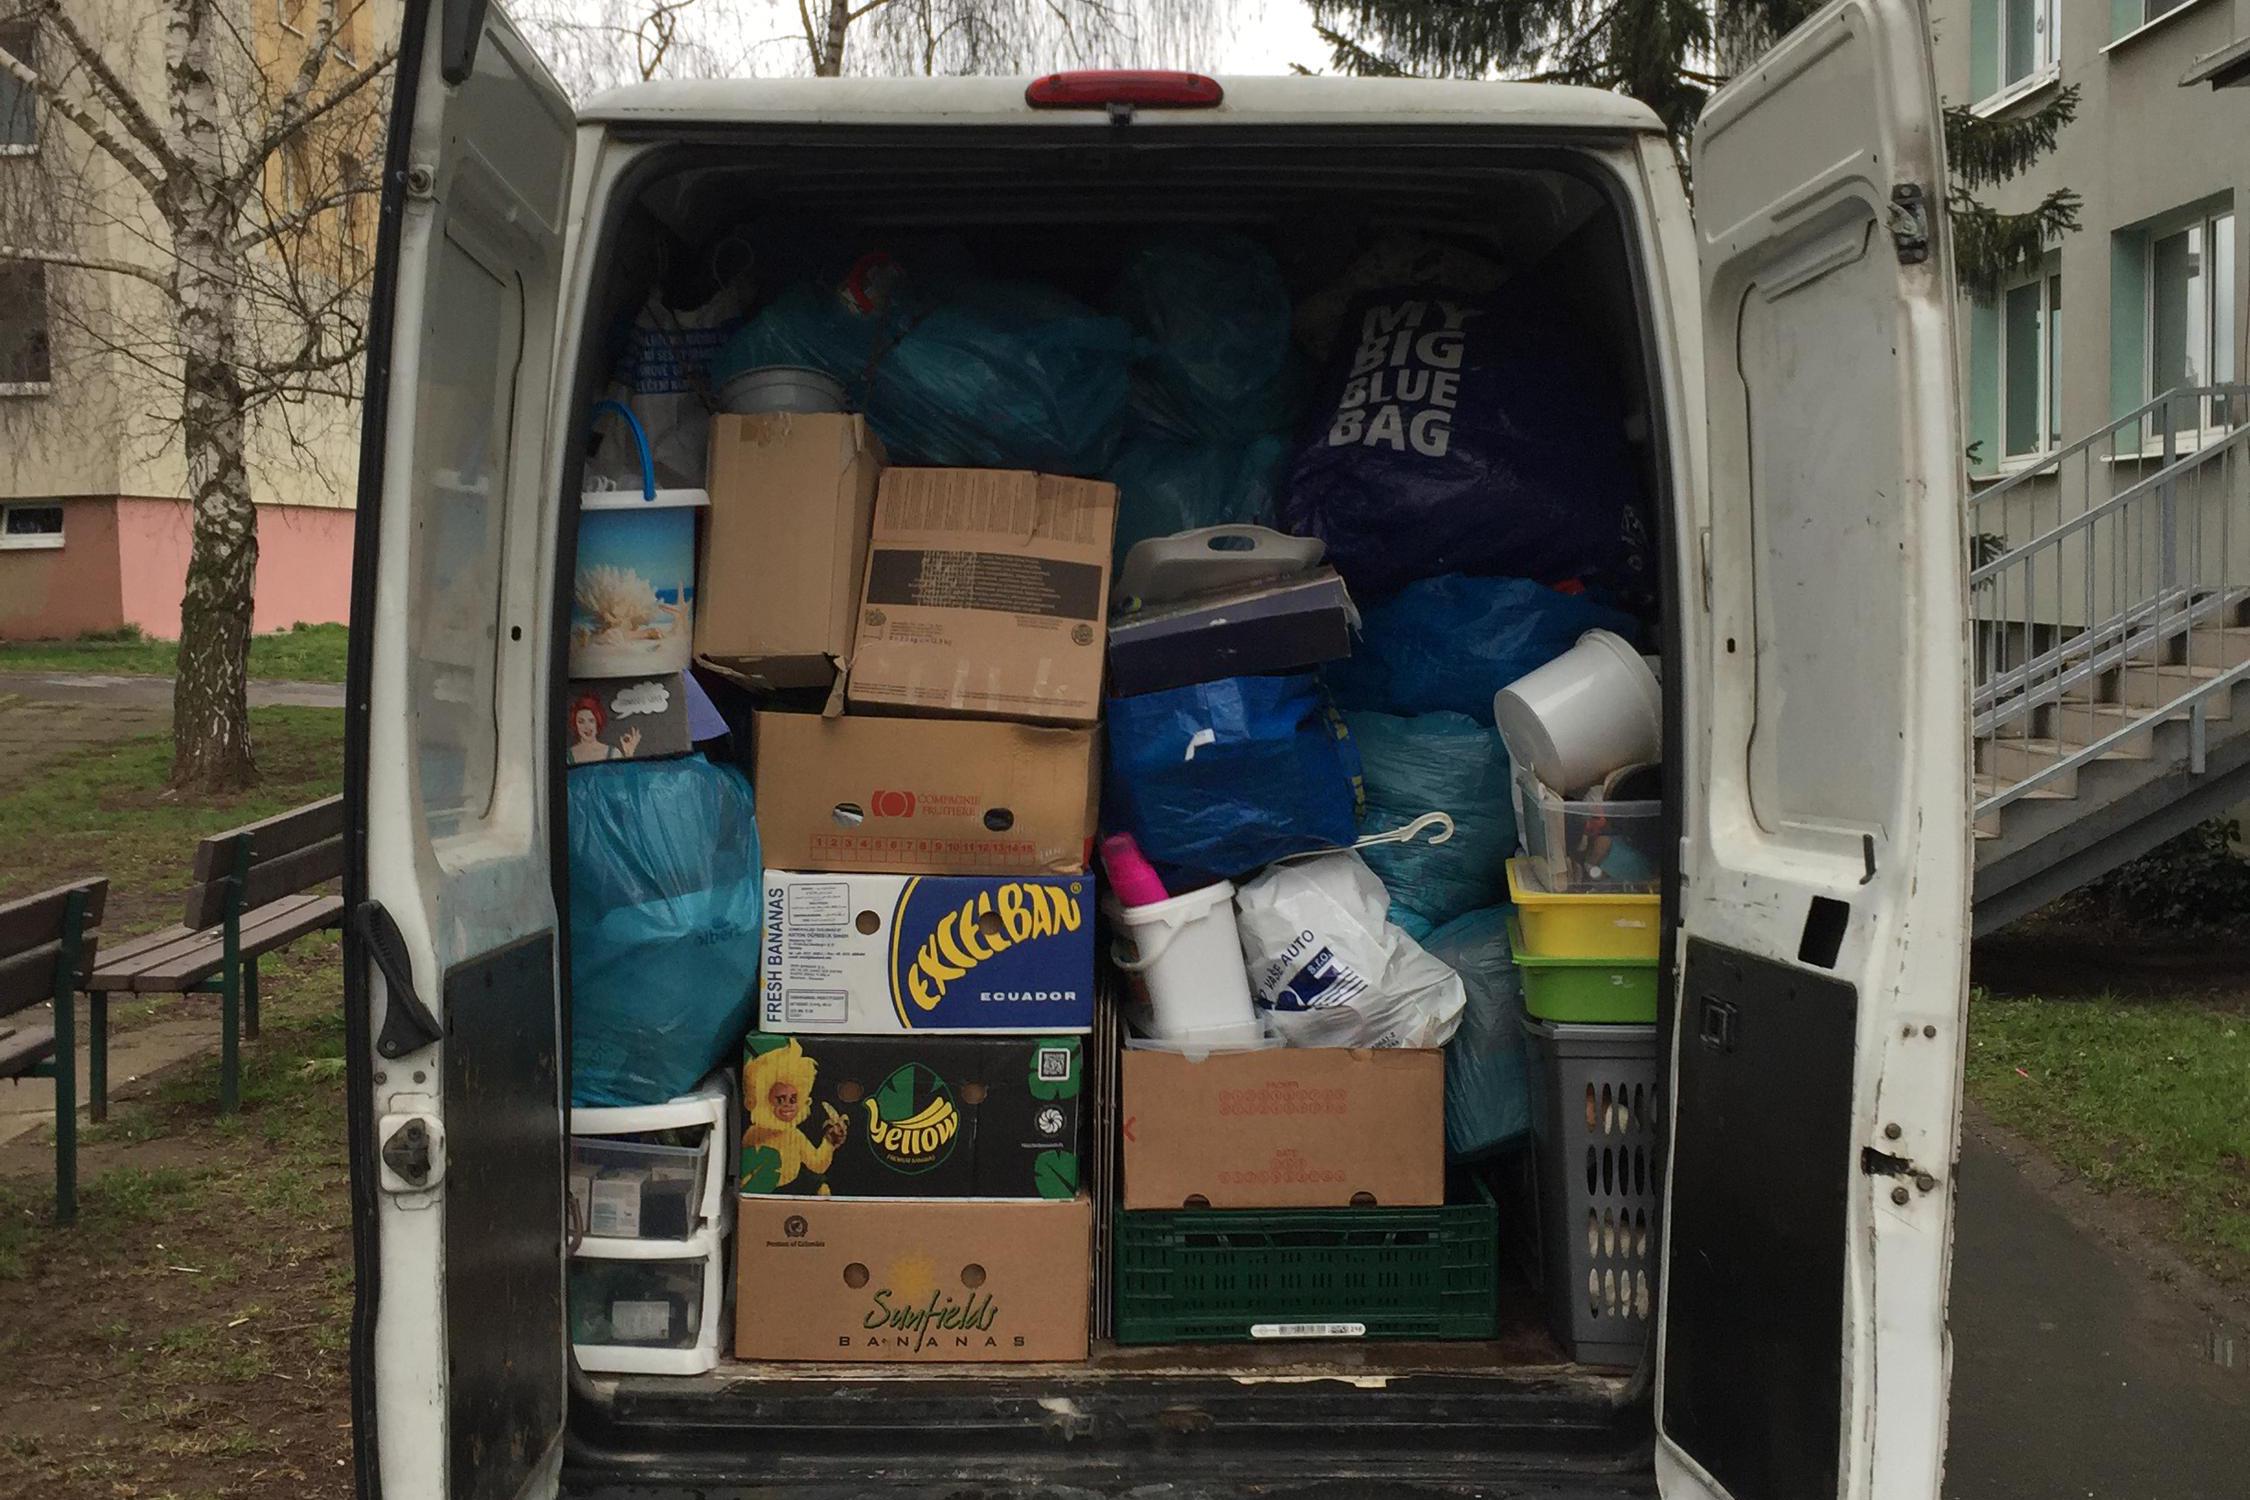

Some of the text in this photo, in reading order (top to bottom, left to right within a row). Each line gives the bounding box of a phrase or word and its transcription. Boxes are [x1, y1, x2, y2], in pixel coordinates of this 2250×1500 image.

[1361, 300, 1484, 344] MY
[1350, 330, 1466, 378] BIG
[1339, 369, 1460, 409] BLUE
[1329, 404, 1452, 457] BAG
[767, 887, 785, 1023] FRESH BANANAS
[1280, 930, 1315, 966] AUTO
[980, 992, 1077, 1001] ECUADOR
[865, 1098, 958, 1154] yellow
[839, 1336, 1026, 1347] BANANAS
